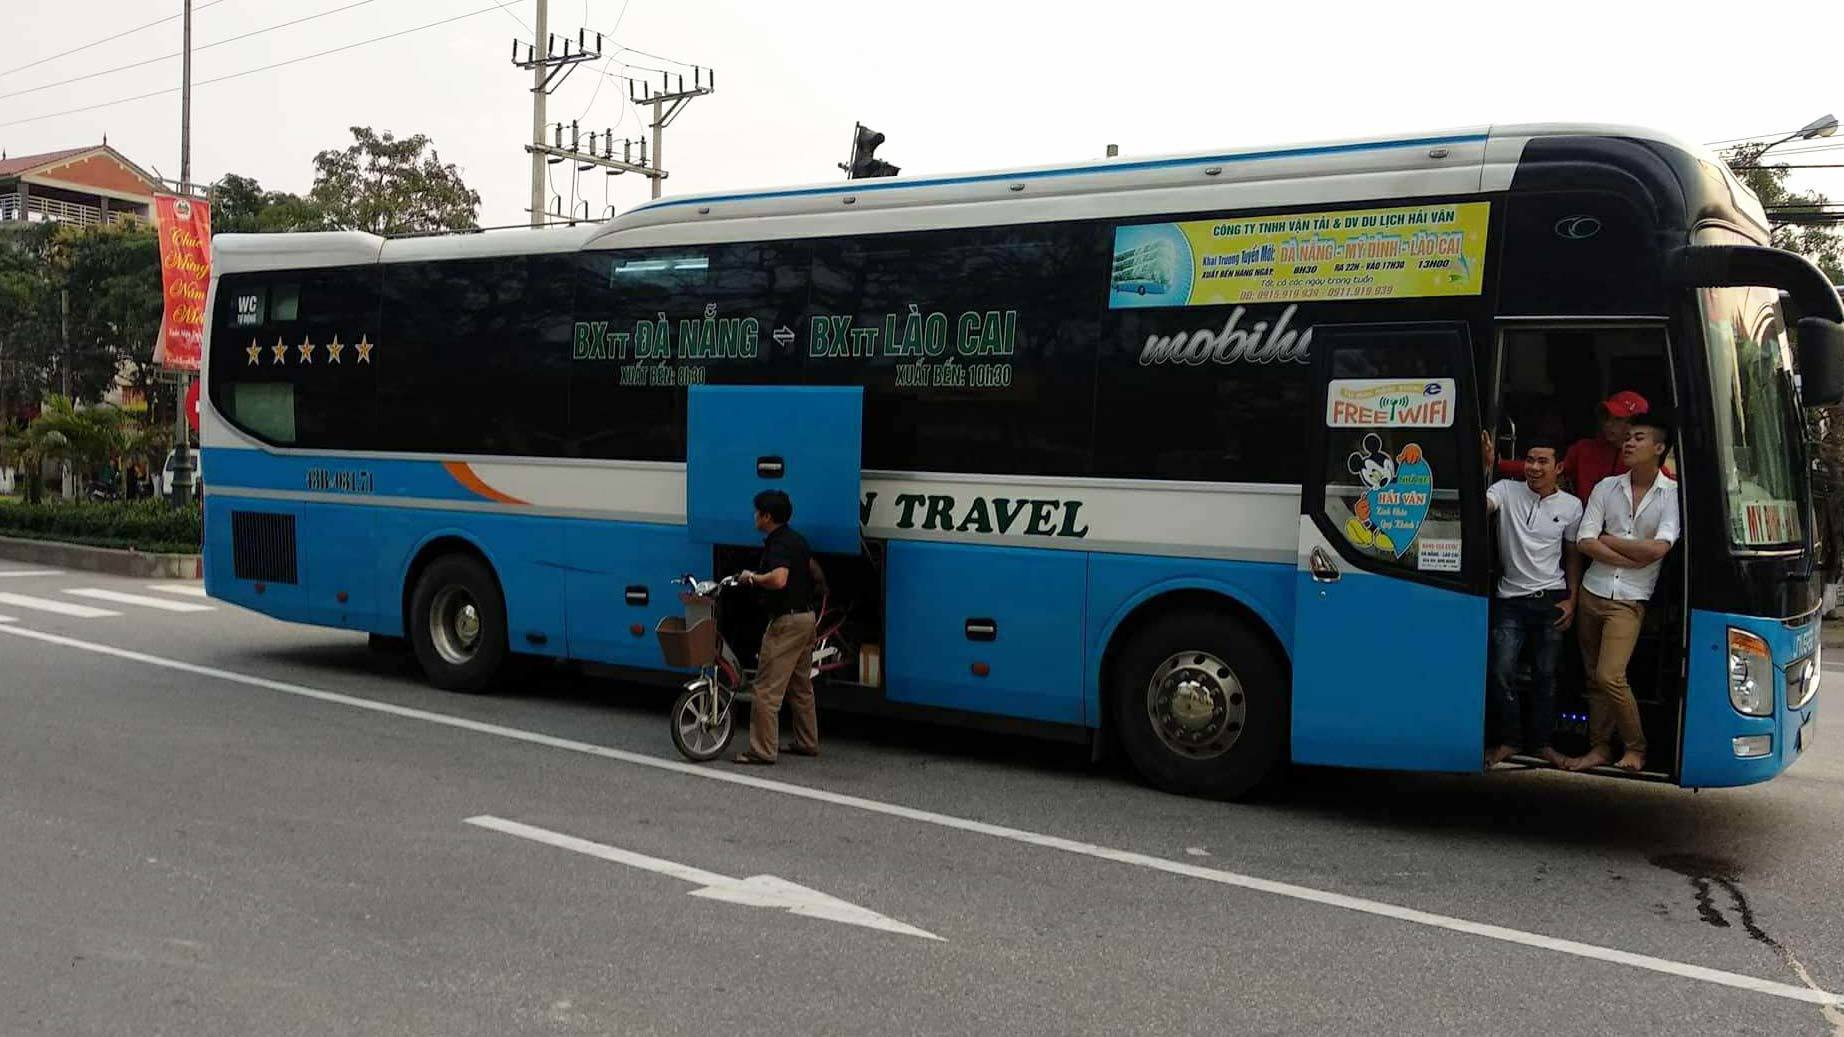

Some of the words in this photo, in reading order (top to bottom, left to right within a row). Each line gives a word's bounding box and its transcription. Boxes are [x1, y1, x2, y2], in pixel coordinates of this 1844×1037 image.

[1213, 223, 1241, 236] CÔNG
[1243, 224, 1257, 234] TY
[1259, 221, 1286, 234] TNHH
[1288, 219, 1310, 232] VẬN
[1313, 215, 1330, 229] TẢI
[1332, 219, 1342, 229] &
[1345, 217, 1359, 228] DV
[1362, 215, 1377, 227] DU
[1380, 213, 1406, 228] LỊCH
[1408, 210, 1427, 225] HẢI
[1431, 210, 1455, 223] VÂN
[238, 295, 258, 313] WC
[634, 312, 671, 359] ĐÀ
[677, 303, 759, 359] NẴNG
[883, 303, 948, 357] LÀO
[957, 310, 1017, 356] CAI
[895, 357, 931, 387] XUẤT
[933, 357, 966, 387] BẾN:
[968, 363, 1013, 388] 10h30
[1332, 399, 1388, 425] FREE
[1397, 399, 1448, 425] WIFI
[894, 494, 1089, 538] TRAVEL
